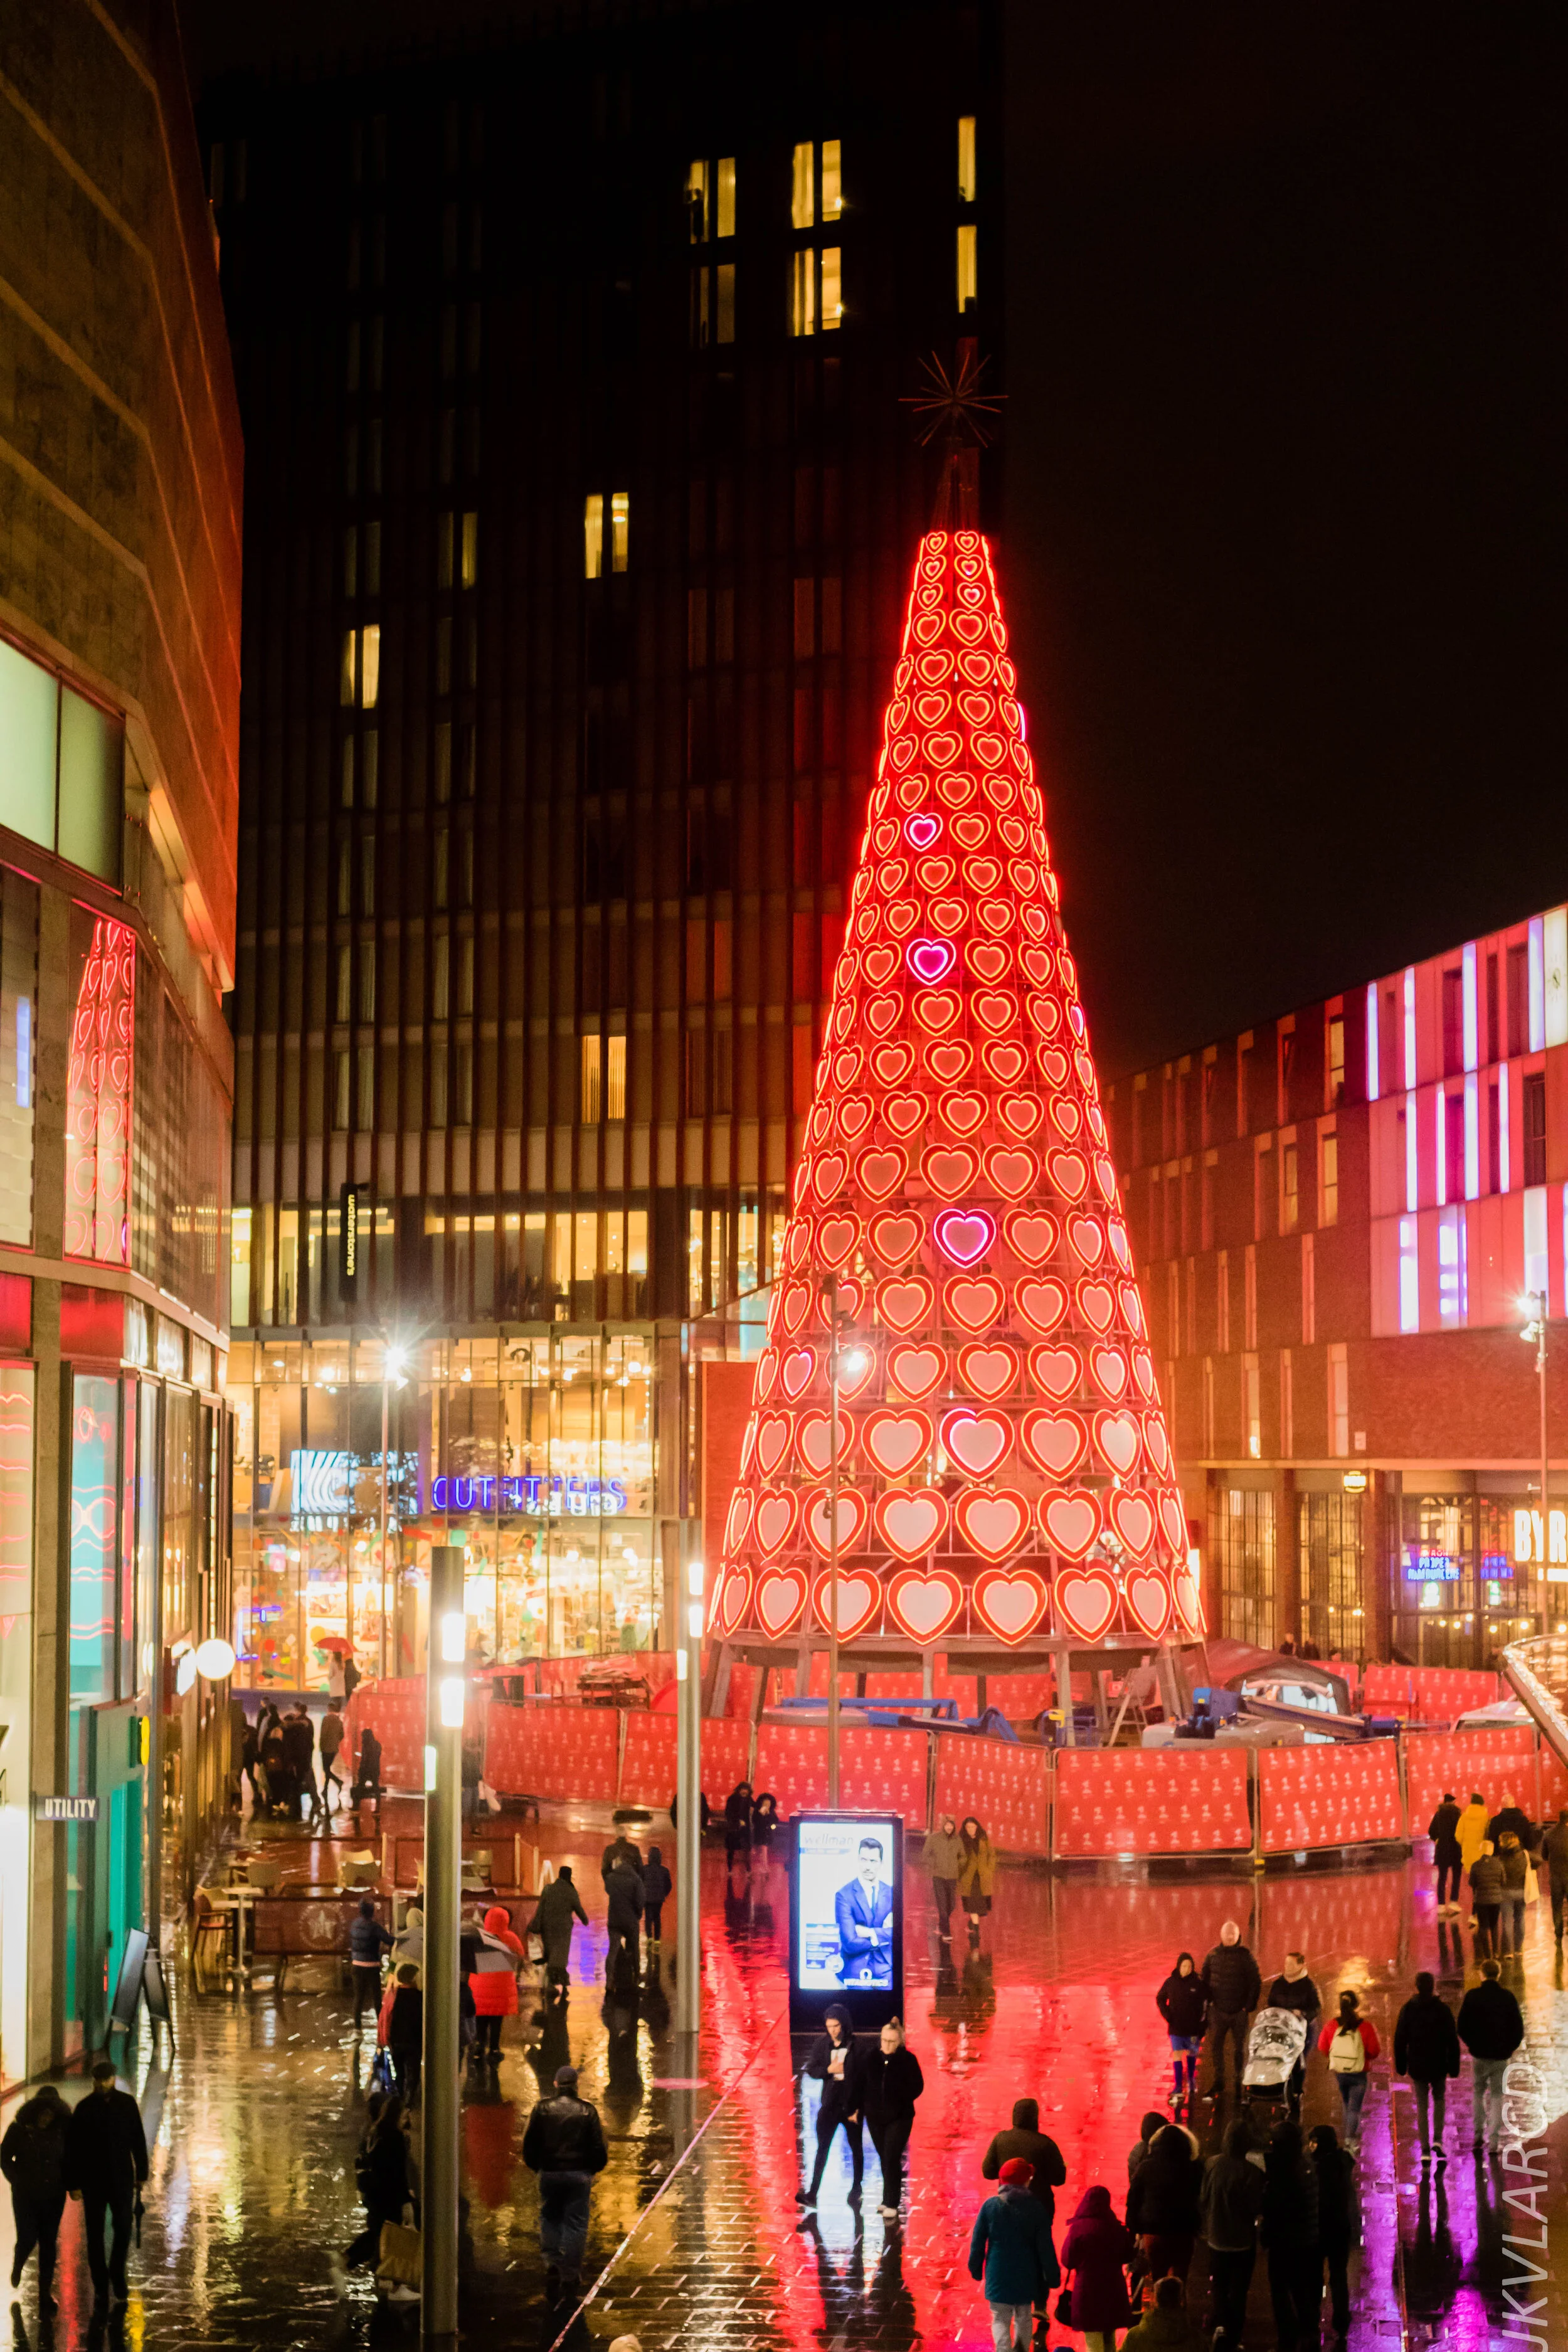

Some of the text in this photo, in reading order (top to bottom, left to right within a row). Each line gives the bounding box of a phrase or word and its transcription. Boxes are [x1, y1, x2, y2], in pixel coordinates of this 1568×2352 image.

[347, 1195, 355, 1275] waterstone's
[1515, 1510, 1568, 1562] BYR
[45, 1799, 95, 1818] UTILITY
[804, 1833, 854, 1845] wellman
